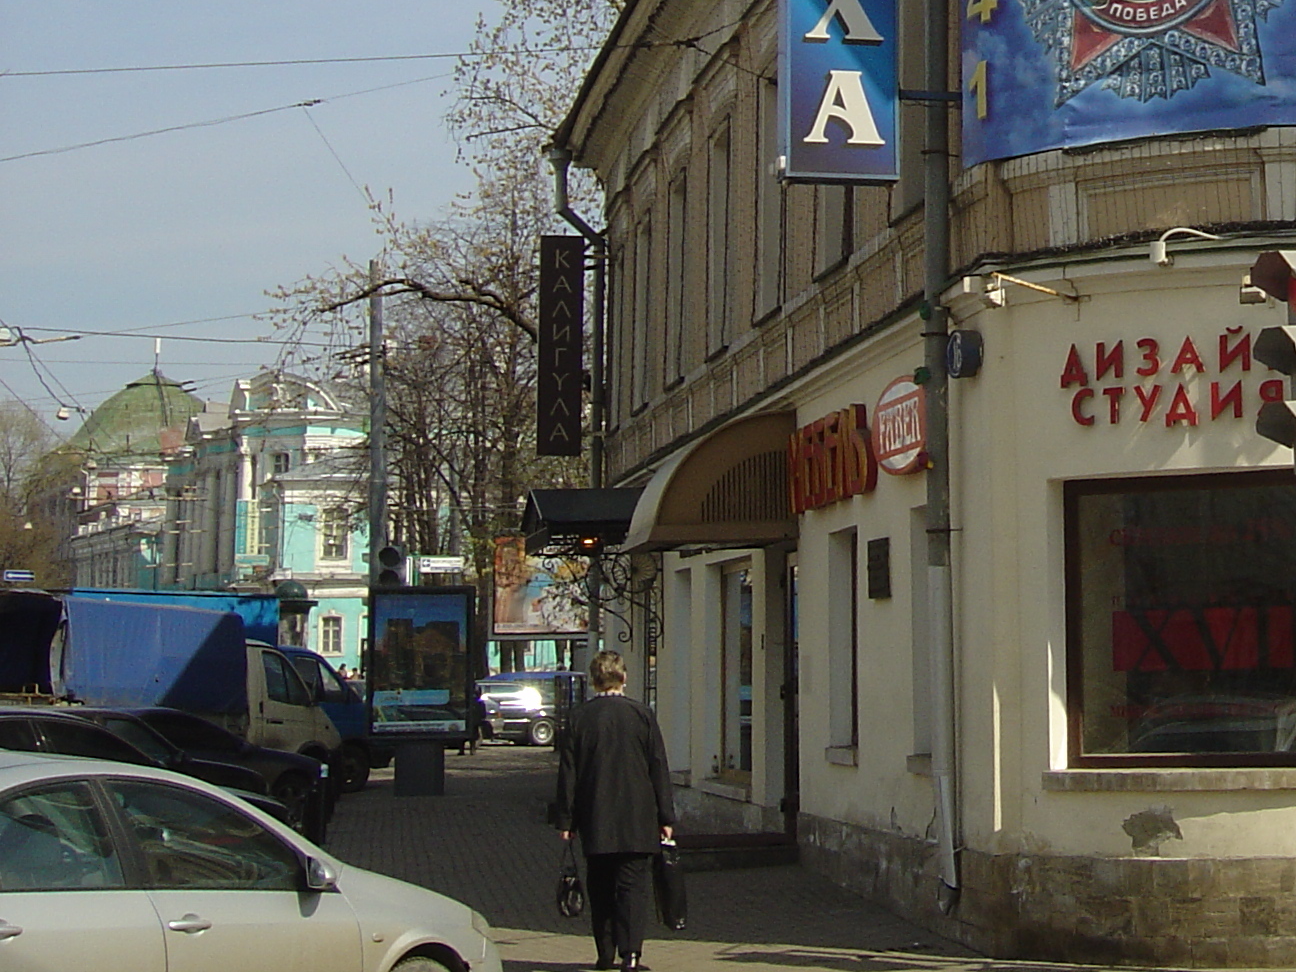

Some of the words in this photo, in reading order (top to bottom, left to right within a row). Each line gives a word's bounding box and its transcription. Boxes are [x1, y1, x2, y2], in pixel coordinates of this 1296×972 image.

[549, 248, 573, 442] КАЛИГУЛА
[1060, 325, 1276, 389] ДИЗАЙ
[879, 396, 921, 455] FABER
[1071, 379, 1284, 427] СТУДИЯ
